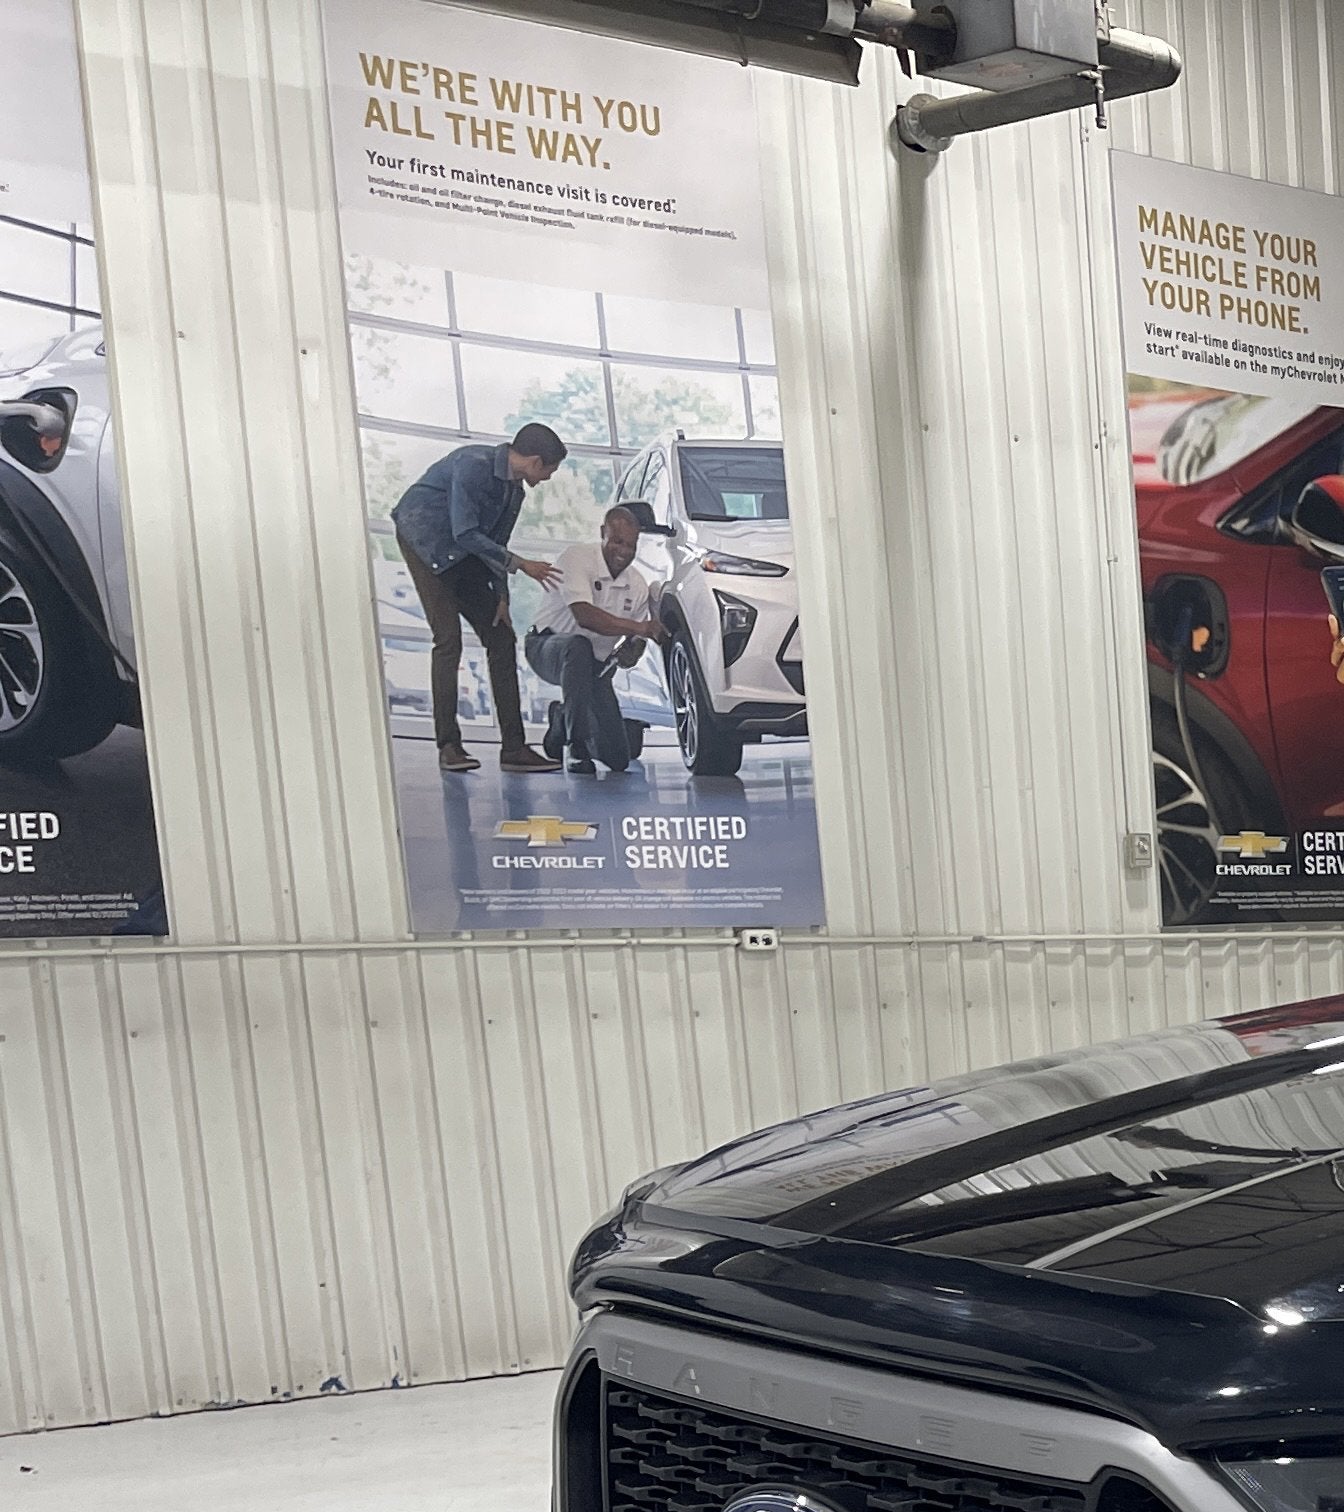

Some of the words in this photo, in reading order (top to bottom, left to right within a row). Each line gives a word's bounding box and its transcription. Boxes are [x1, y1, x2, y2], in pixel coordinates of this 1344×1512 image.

[359, 53, 478, 106] WE'RE
[489, 78, 583, 124] WITH
[594, 96, 661, 136] YOU
[364, 98, 435, 141] ALL
[446, 112, 516, 155] THE
[526, 126, 611, 170] WAY.
[366, 150, 404, 170] Your
[410, 157, 445, 178] first
[451, 169, 553, 195] maintenance
[558, 184, 590, 201] visit
[595, 188, 607, 203] is
[1138, 205, 1246, 253] MANAGE
[1254, 230, 1318, 267] YOUR
[1140, 241, 1247, 289] VEHICLE
[1256, 265, 1320, 301] FROM
[1142, 277, 1212, 318] YOUR
[1220, 294, 1309, 334] PHONE.
[1144, 321, 1172, 339] View
[1176, 331, 1228, 349] real-time
[1232, 339, 1293, 360] diagnostics
[1296, 352, 1315, 363] and
[1318, 354, 1344, 370] enjoy
[1182, 350, 1230, 367] available
[1234, 359, 1247, 370] on
[1250, 360, 1267, 373] the
[1271, 365, 1337, 384] myChevrolet
[622, 817, 746, 840] CERTIFIED
[492, 856, 606, 868] CHEVROLET
[625, 845, 730, 868] SERVICE
[1216, 864, 1292, 875] CHEVROLET
[609, 1342, 1058, 1457] RANGER
